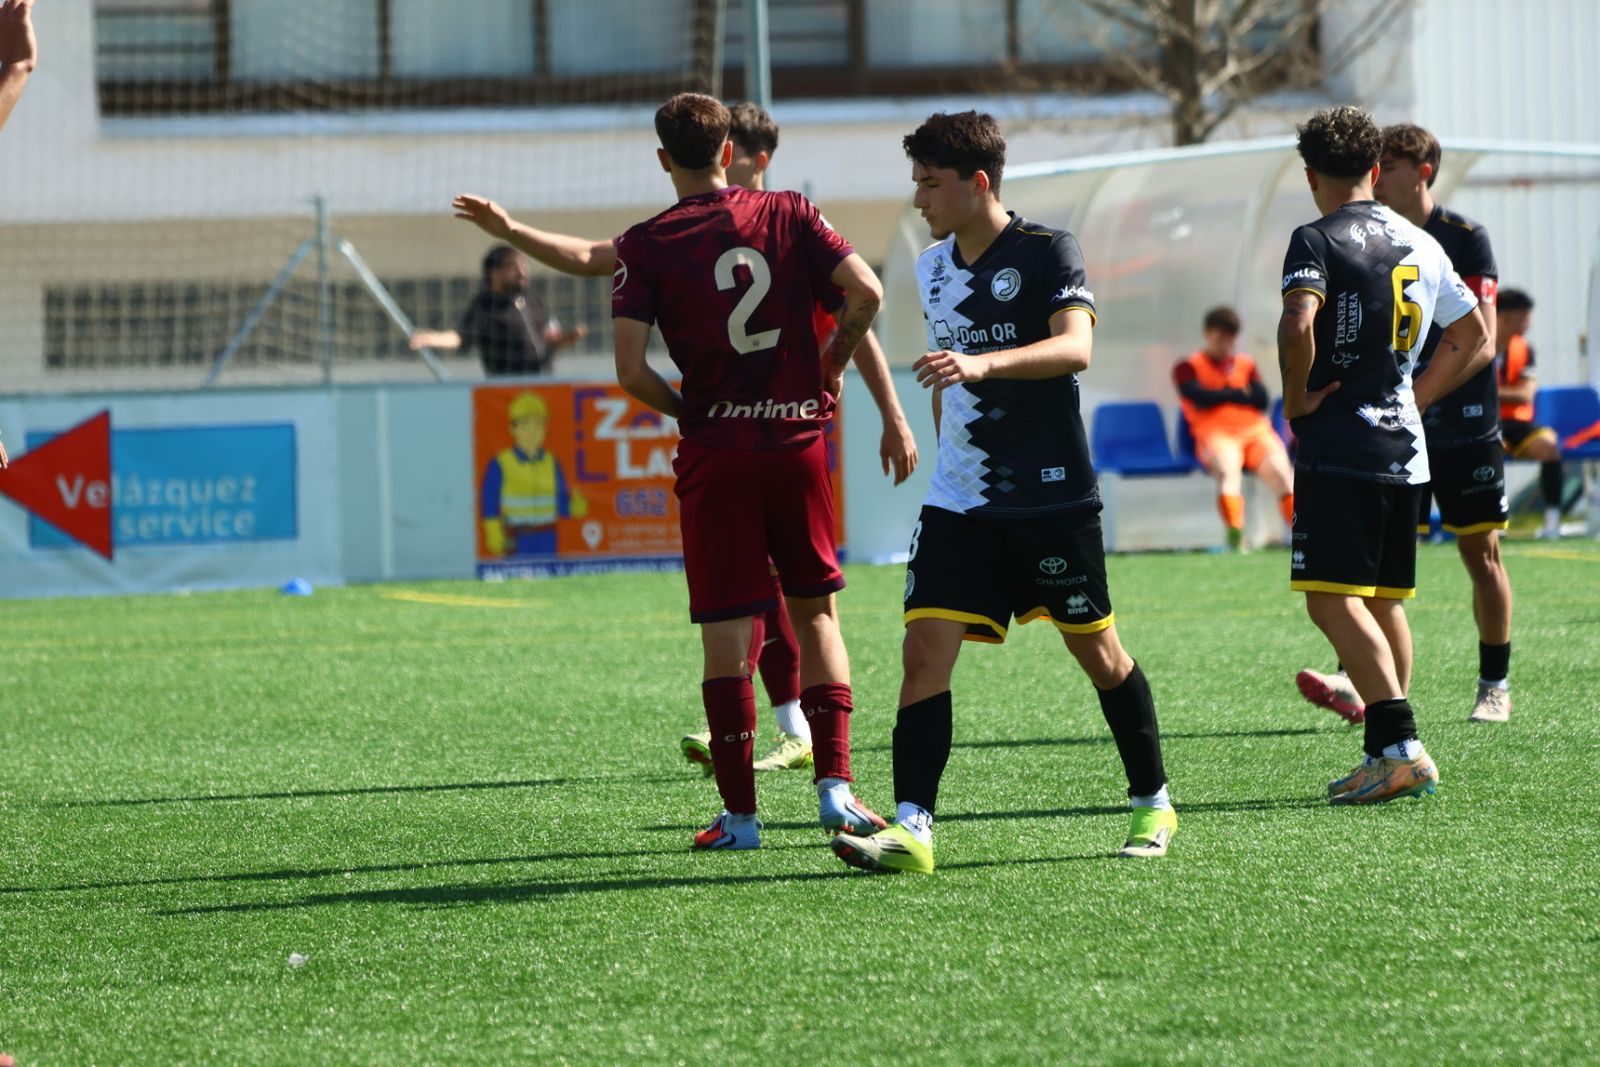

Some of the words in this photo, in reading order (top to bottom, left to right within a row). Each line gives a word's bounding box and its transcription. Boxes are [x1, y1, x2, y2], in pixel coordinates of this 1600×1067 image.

[714, 247, 781, 355] 2
[1335, 291, 1347, 347] TERNERA
[1346, 292, 1358, 342] CHARRA
[1391, 265, 1423, 352] 6
[959, 327, 989, 344] Don
[991, 323, 1017, 343] QR
[708, 399, 819, 419] Ontime
[616, 439, 679, 480] LA
[55, 471, 257, 509] Velázquez
[118, 504, 256, 541] service
